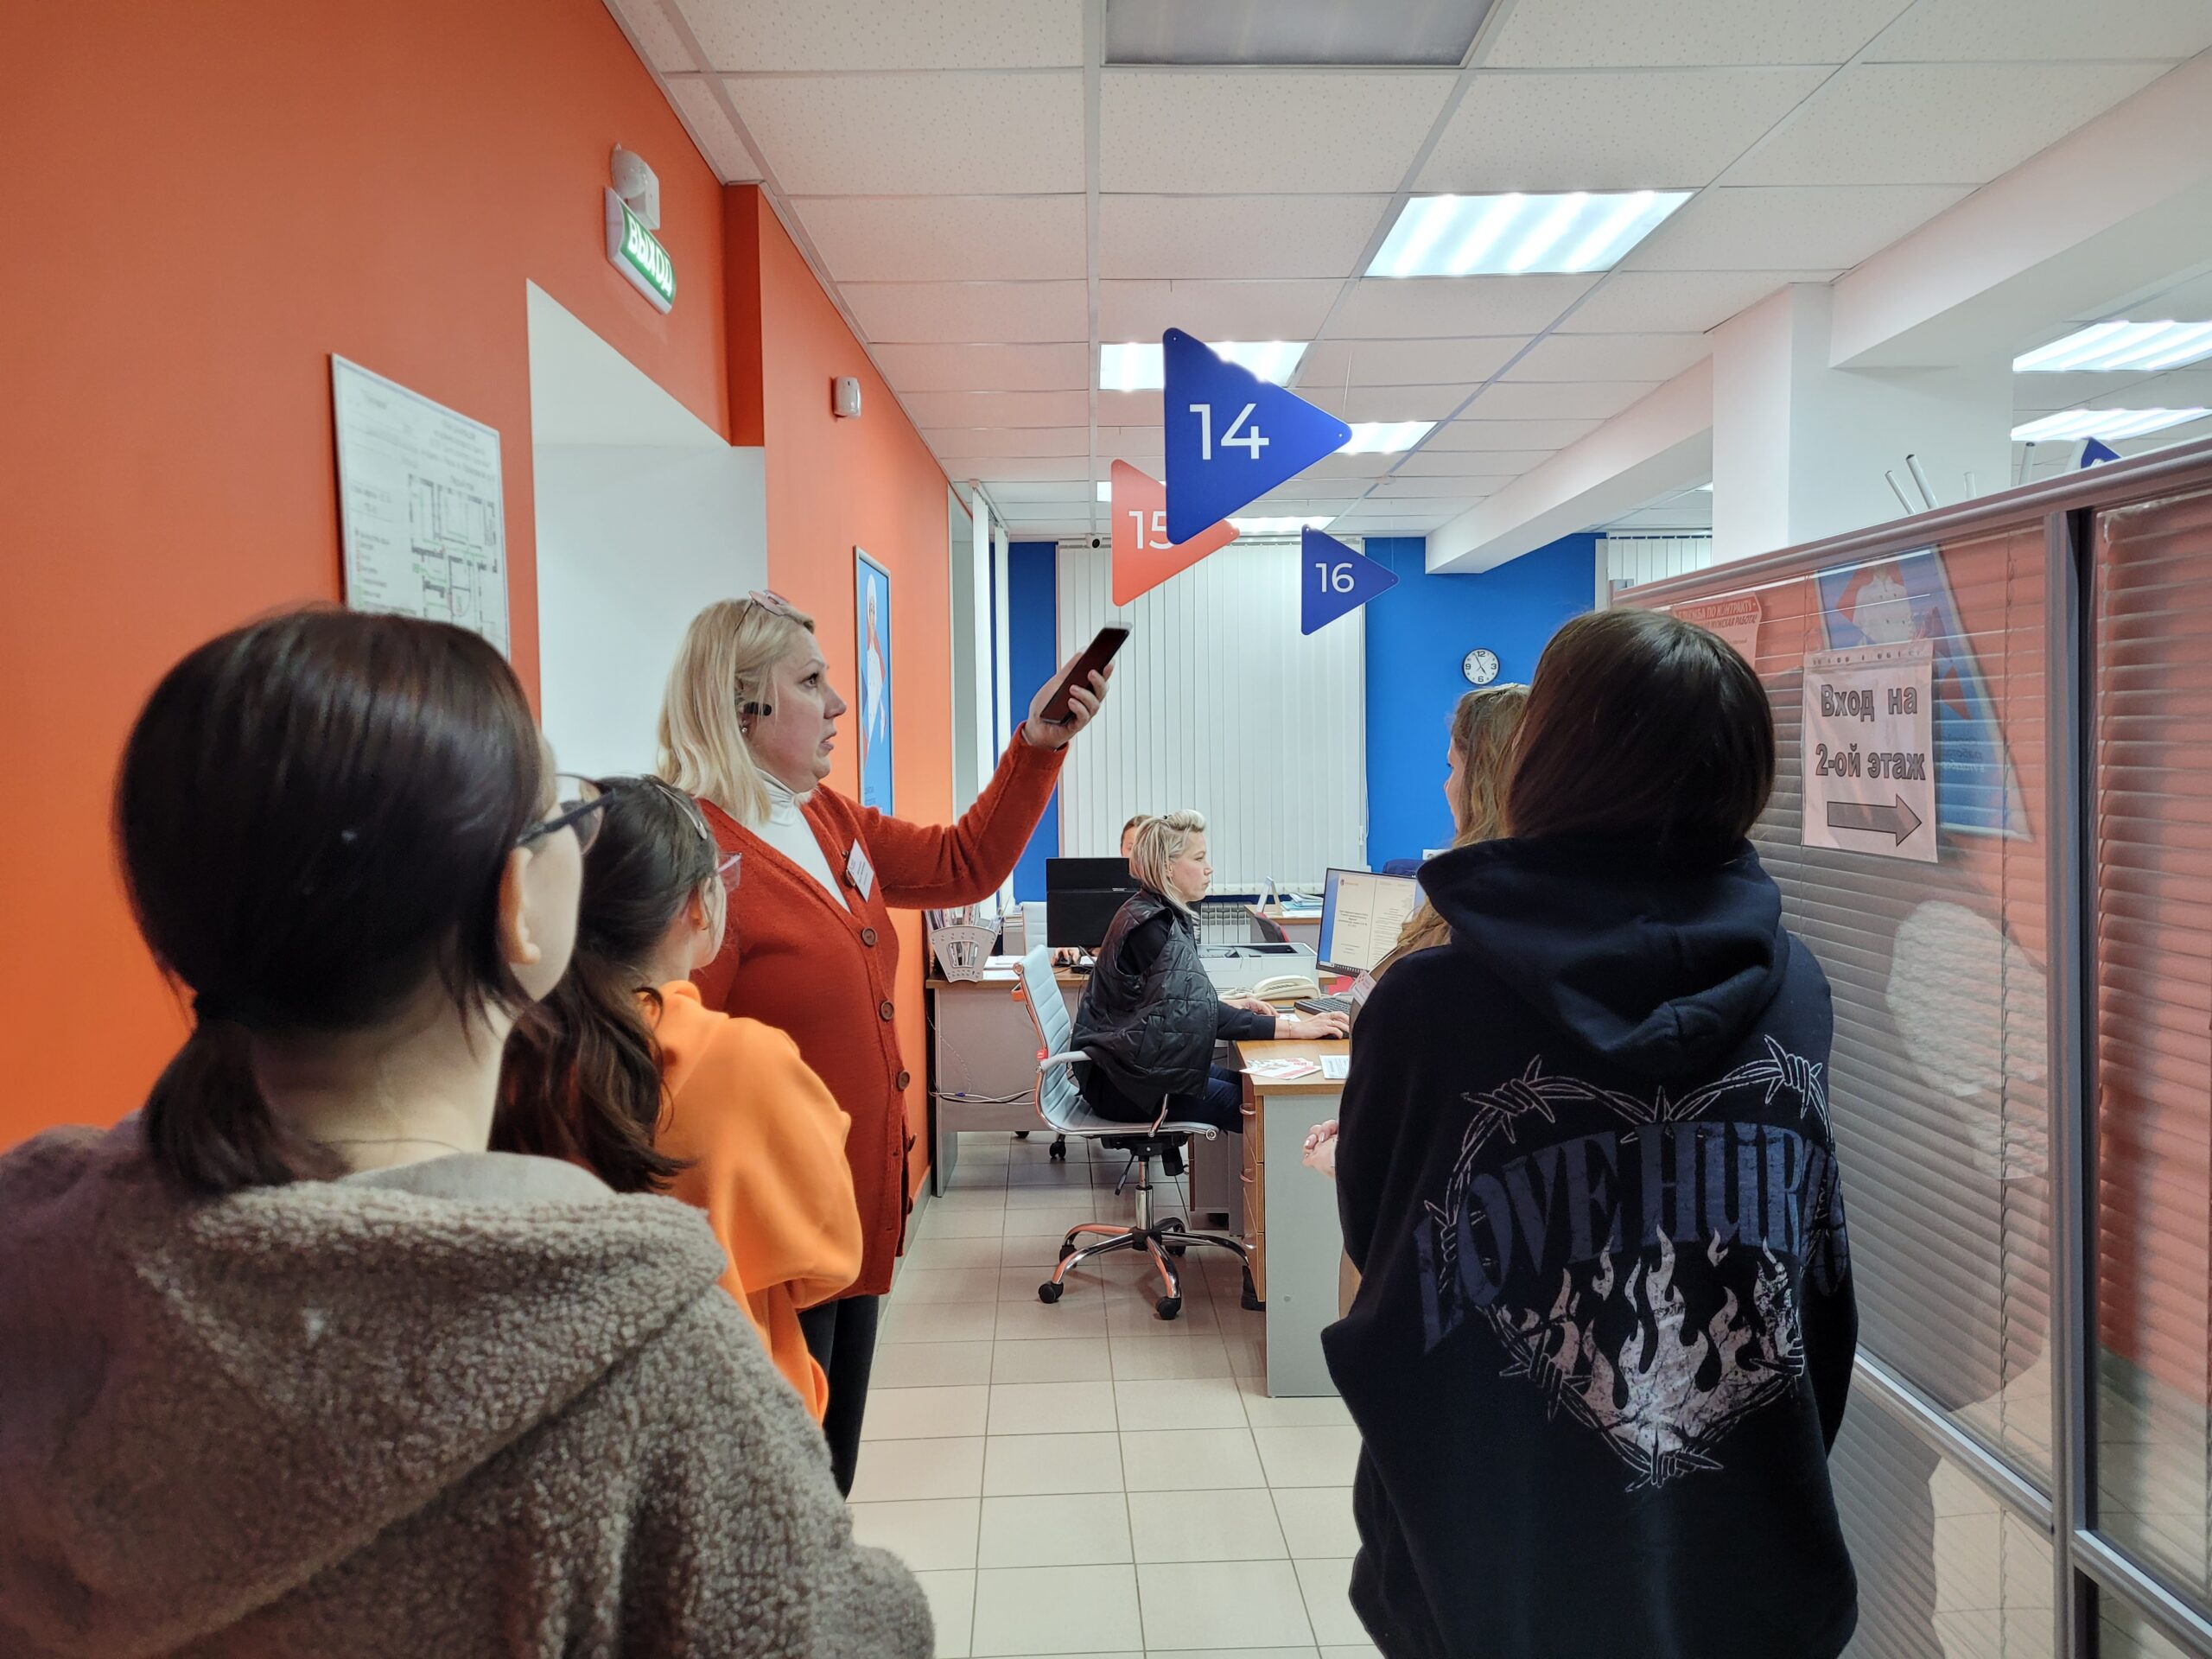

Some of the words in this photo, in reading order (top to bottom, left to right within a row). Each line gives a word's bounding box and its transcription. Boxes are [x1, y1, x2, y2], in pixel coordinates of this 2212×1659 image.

[627, 213, 673, 297] ВЫХОД
[1189, 403, 1270, 460] 14
[1315, 563, 1355, 594] 16
[1707, 606, 1717, 618] ПО
[1717, 601, 1752, 617] КОНТРАКТУ
[1821, 683, 1875, 722] Вход
[1888, 687, 1917, 715] на
[1815, 742, 1861, 778] 2-ой
[1867, 752, 1926, 780] этаж
[1414, 1130, 1624, 1355] LOVE
